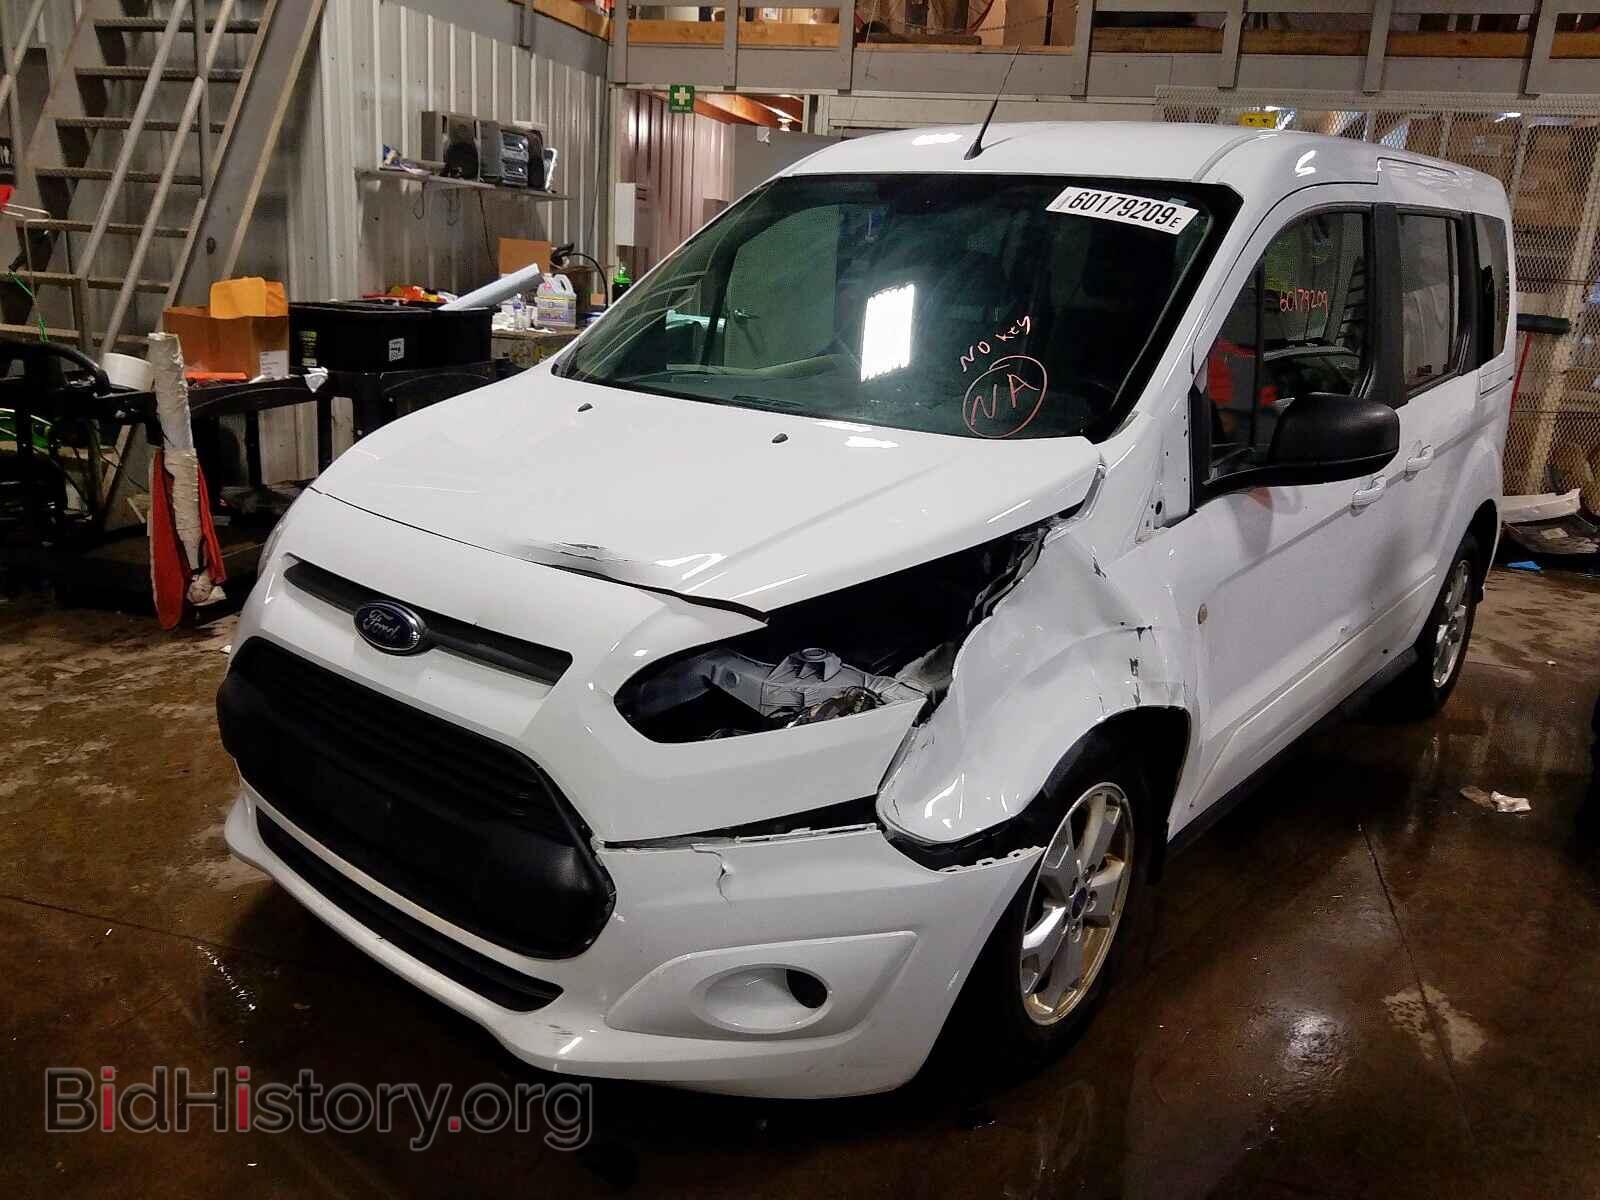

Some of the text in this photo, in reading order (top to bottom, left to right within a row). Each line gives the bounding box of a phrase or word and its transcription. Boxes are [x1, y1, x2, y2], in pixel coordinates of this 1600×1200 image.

[1068, 191, 1177, 225] 60179209
[1168, 217, 1182, 228] E
[363, 608, 401, 637] Ford
